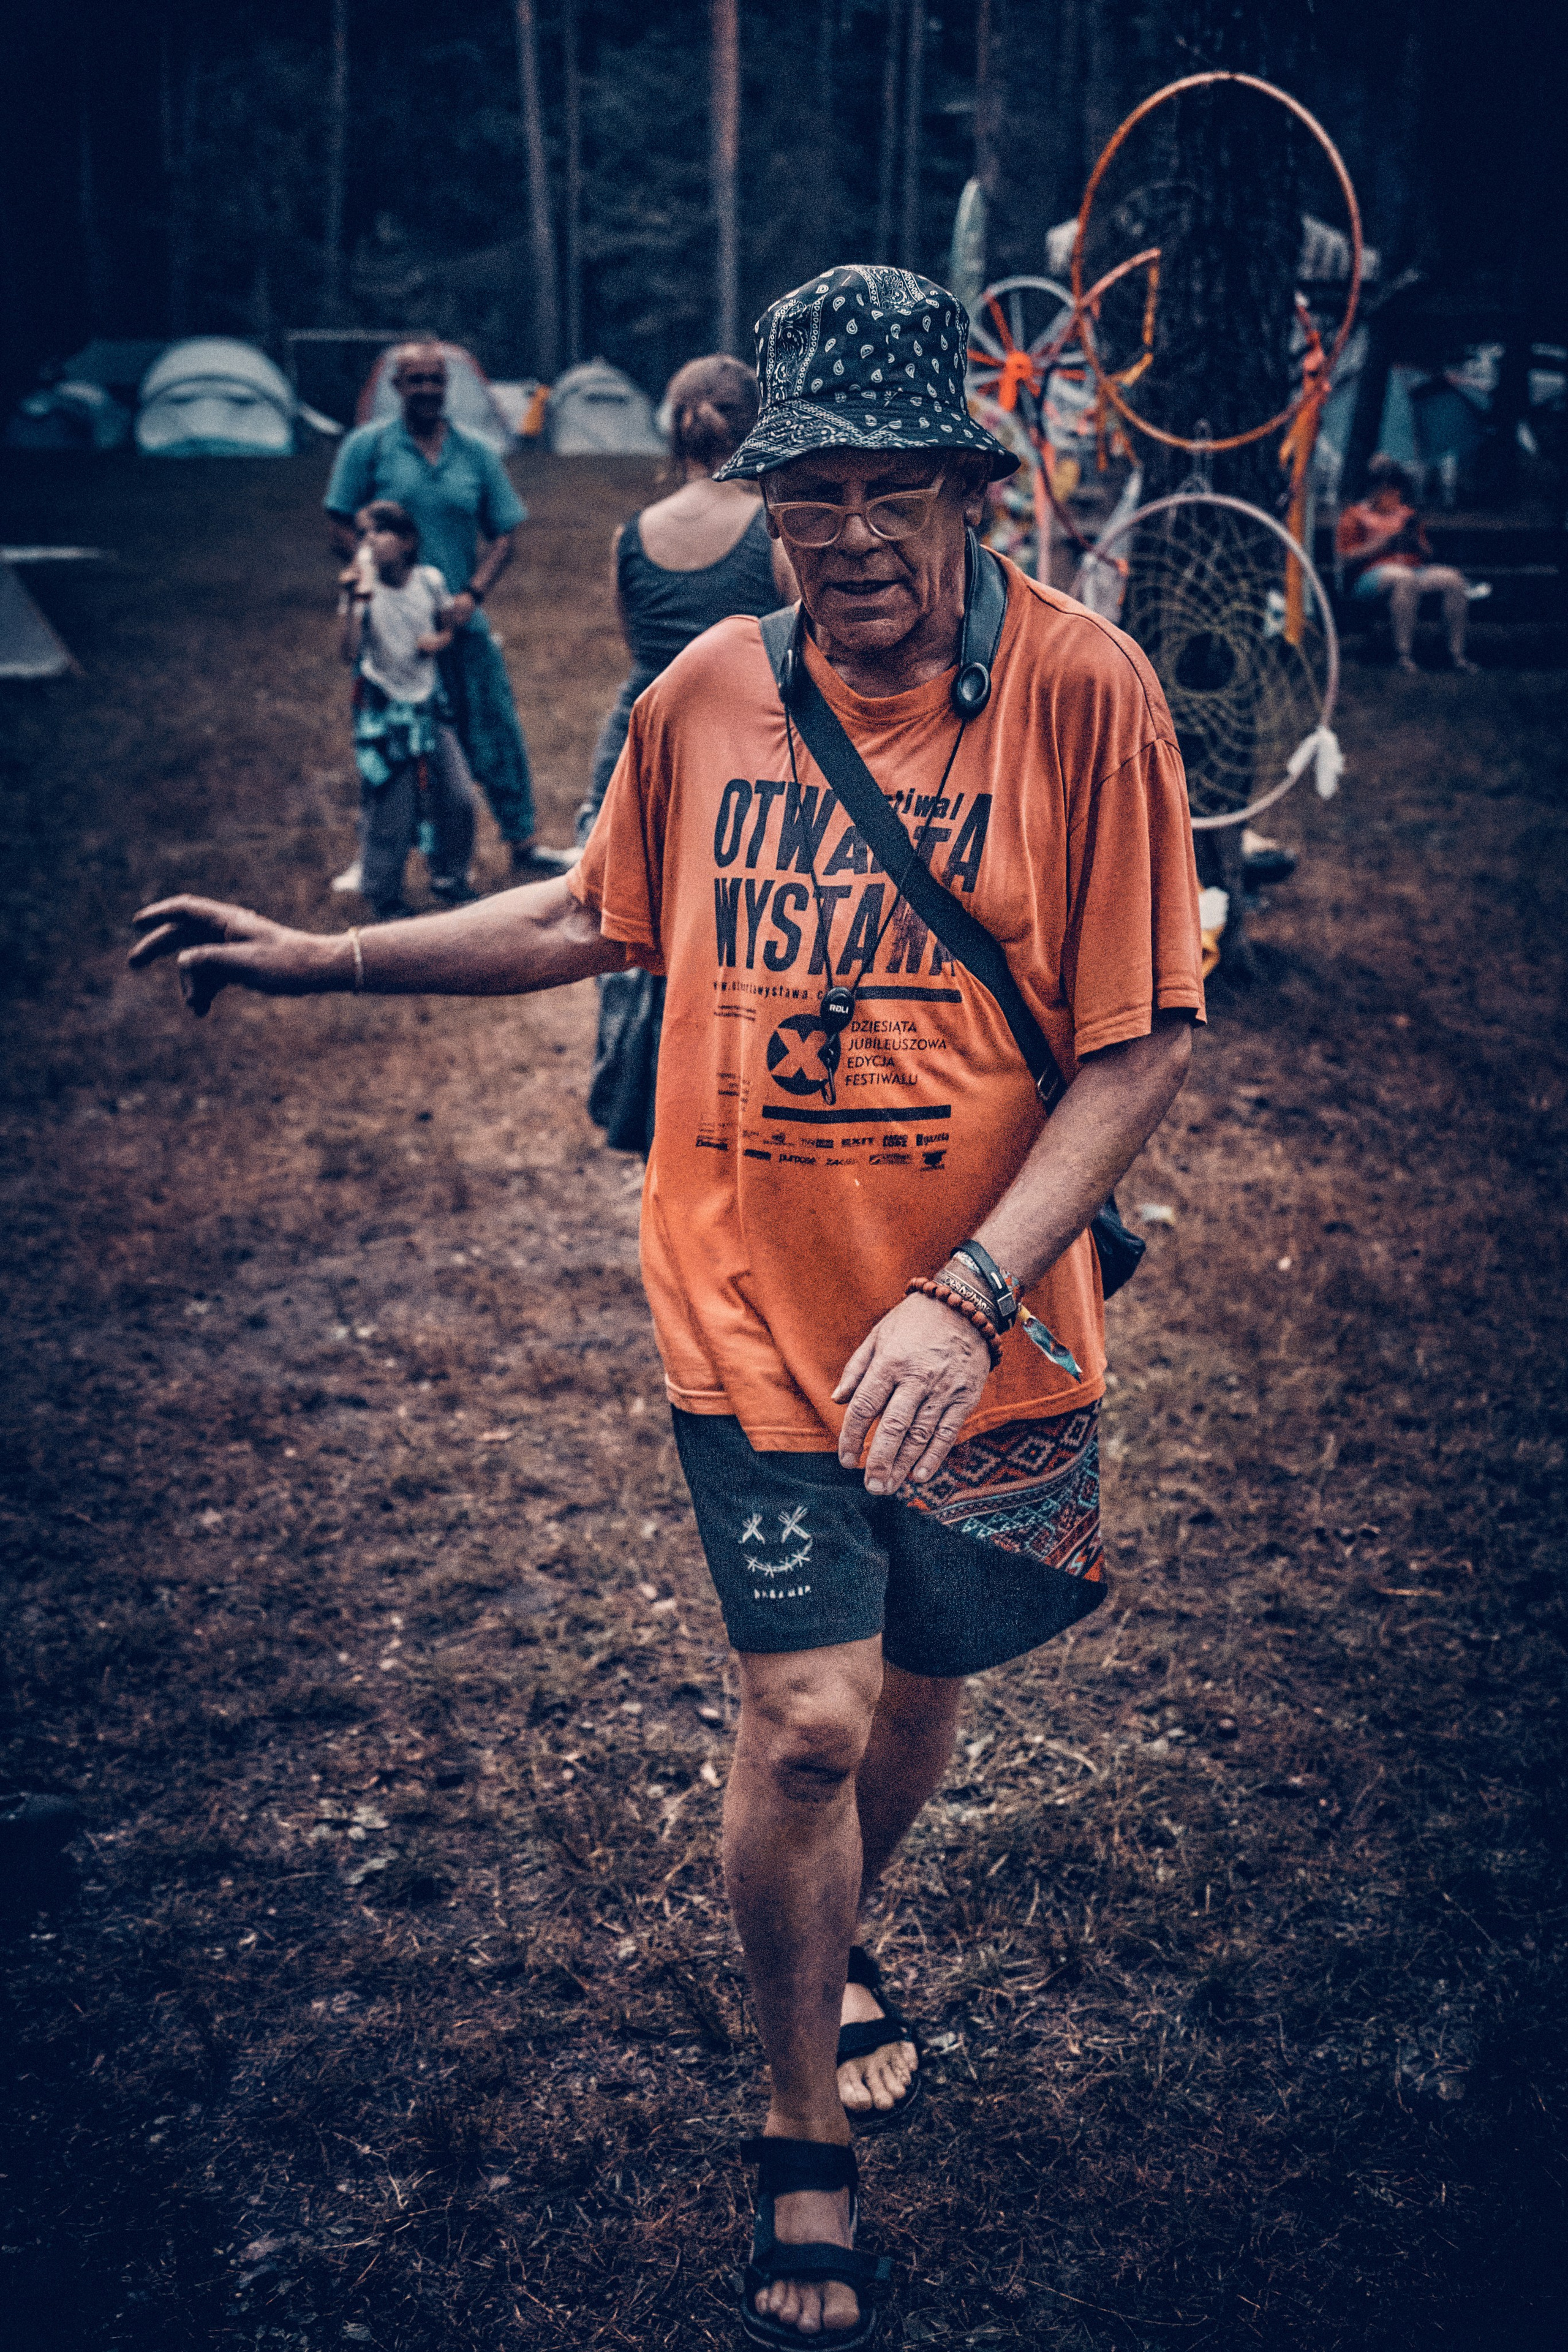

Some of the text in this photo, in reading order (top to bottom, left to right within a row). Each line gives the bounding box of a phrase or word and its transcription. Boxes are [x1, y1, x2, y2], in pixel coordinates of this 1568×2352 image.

[886, 788, 965, 821] tiwal
[714, 778, 993, 893] OTWATA
[851, 1019, 918, 1035] DZIESIĄTA
[848, 1037, 947, 1052] JUBILEUSZOWA
[846, 1055, 895, 1069] EDYCJA
